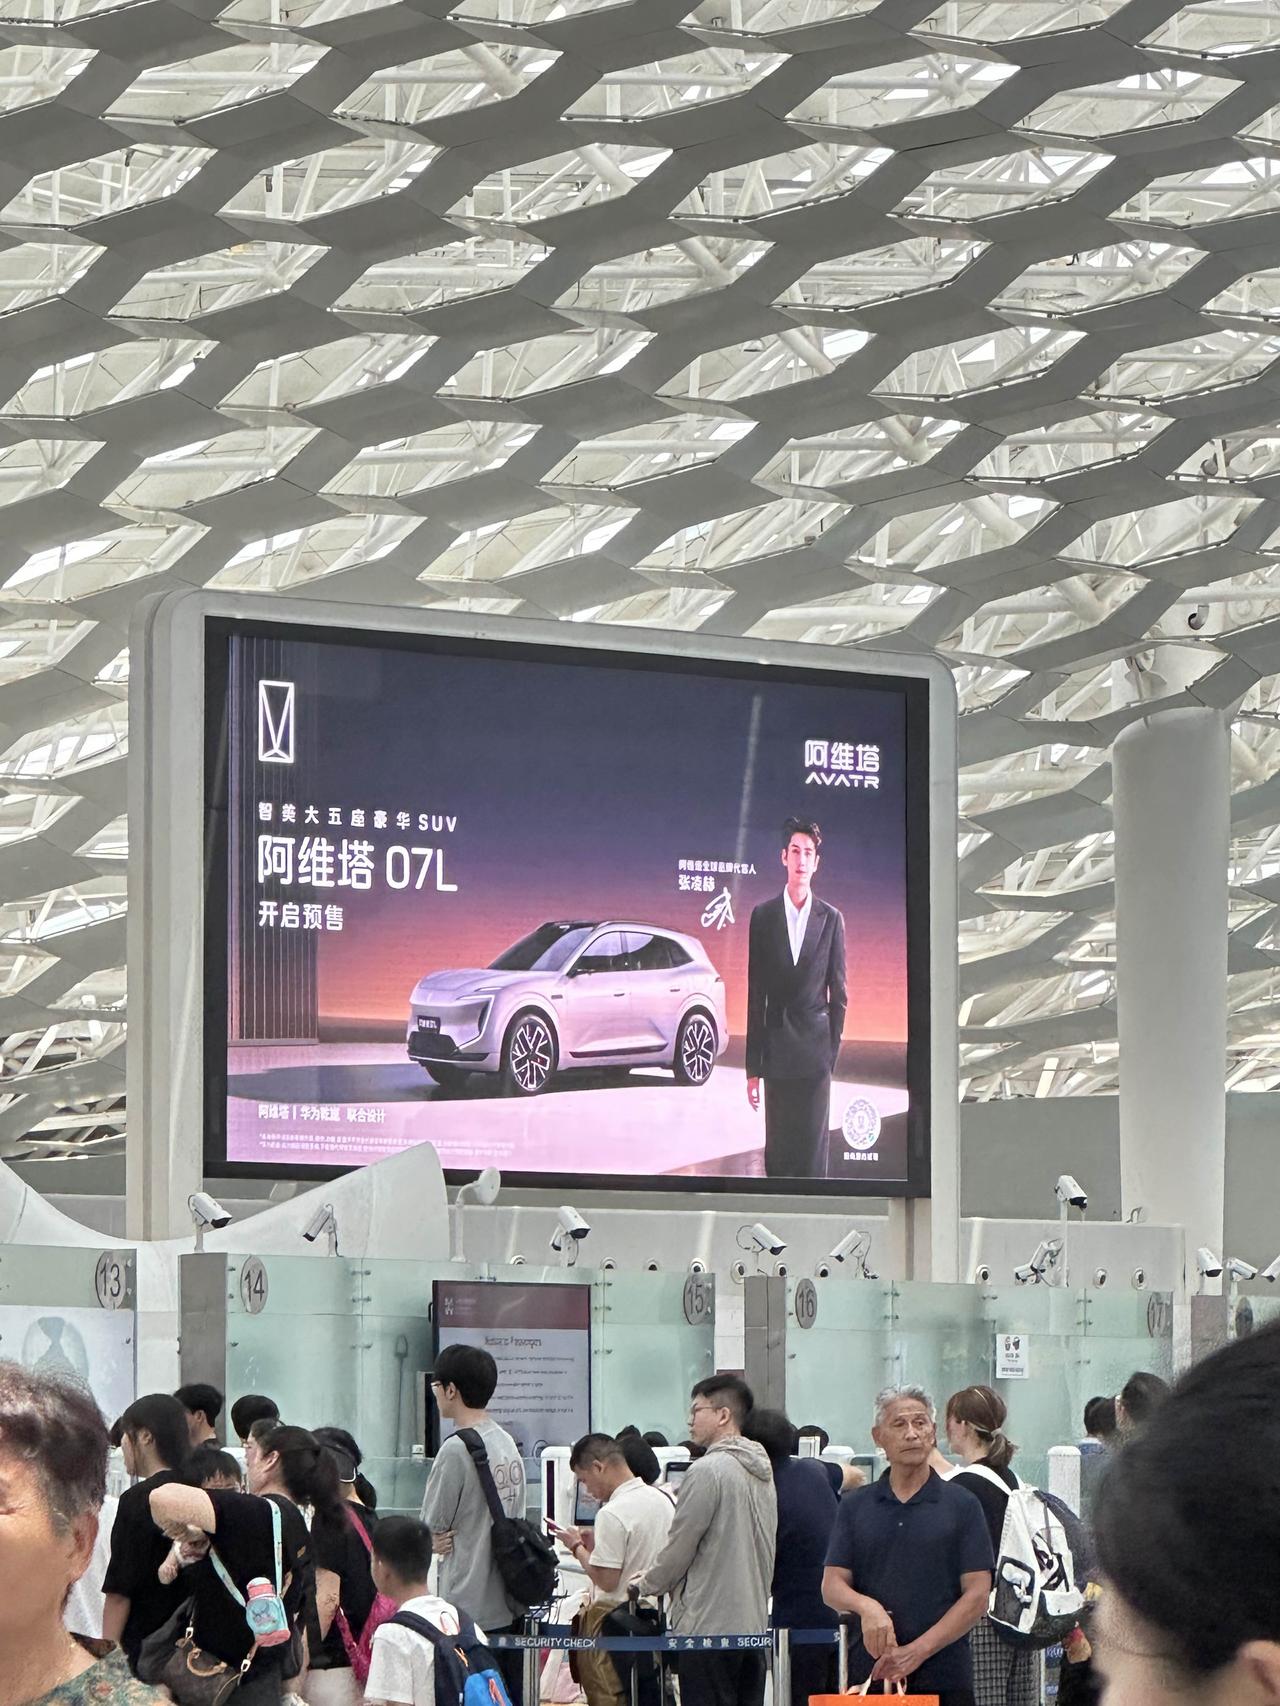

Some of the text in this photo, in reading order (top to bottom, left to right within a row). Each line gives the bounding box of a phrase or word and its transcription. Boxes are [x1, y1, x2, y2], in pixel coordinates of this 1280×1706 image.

[804, 739, 880, 772] 阿维塔
[805, 772, 880, 789] AVATR
[257, 834, 458, 892] 阿维塔 07L
[258, 901, 344, 931] 开启预售
[100, 1262, 121, 1298] 13
[244, 1269, 265, 1304] 14
[687, 1284, 704, 1314] 15
[798, 1288, 815, 1318] 16
[514, 1637, 562, 1648] SECURITY
